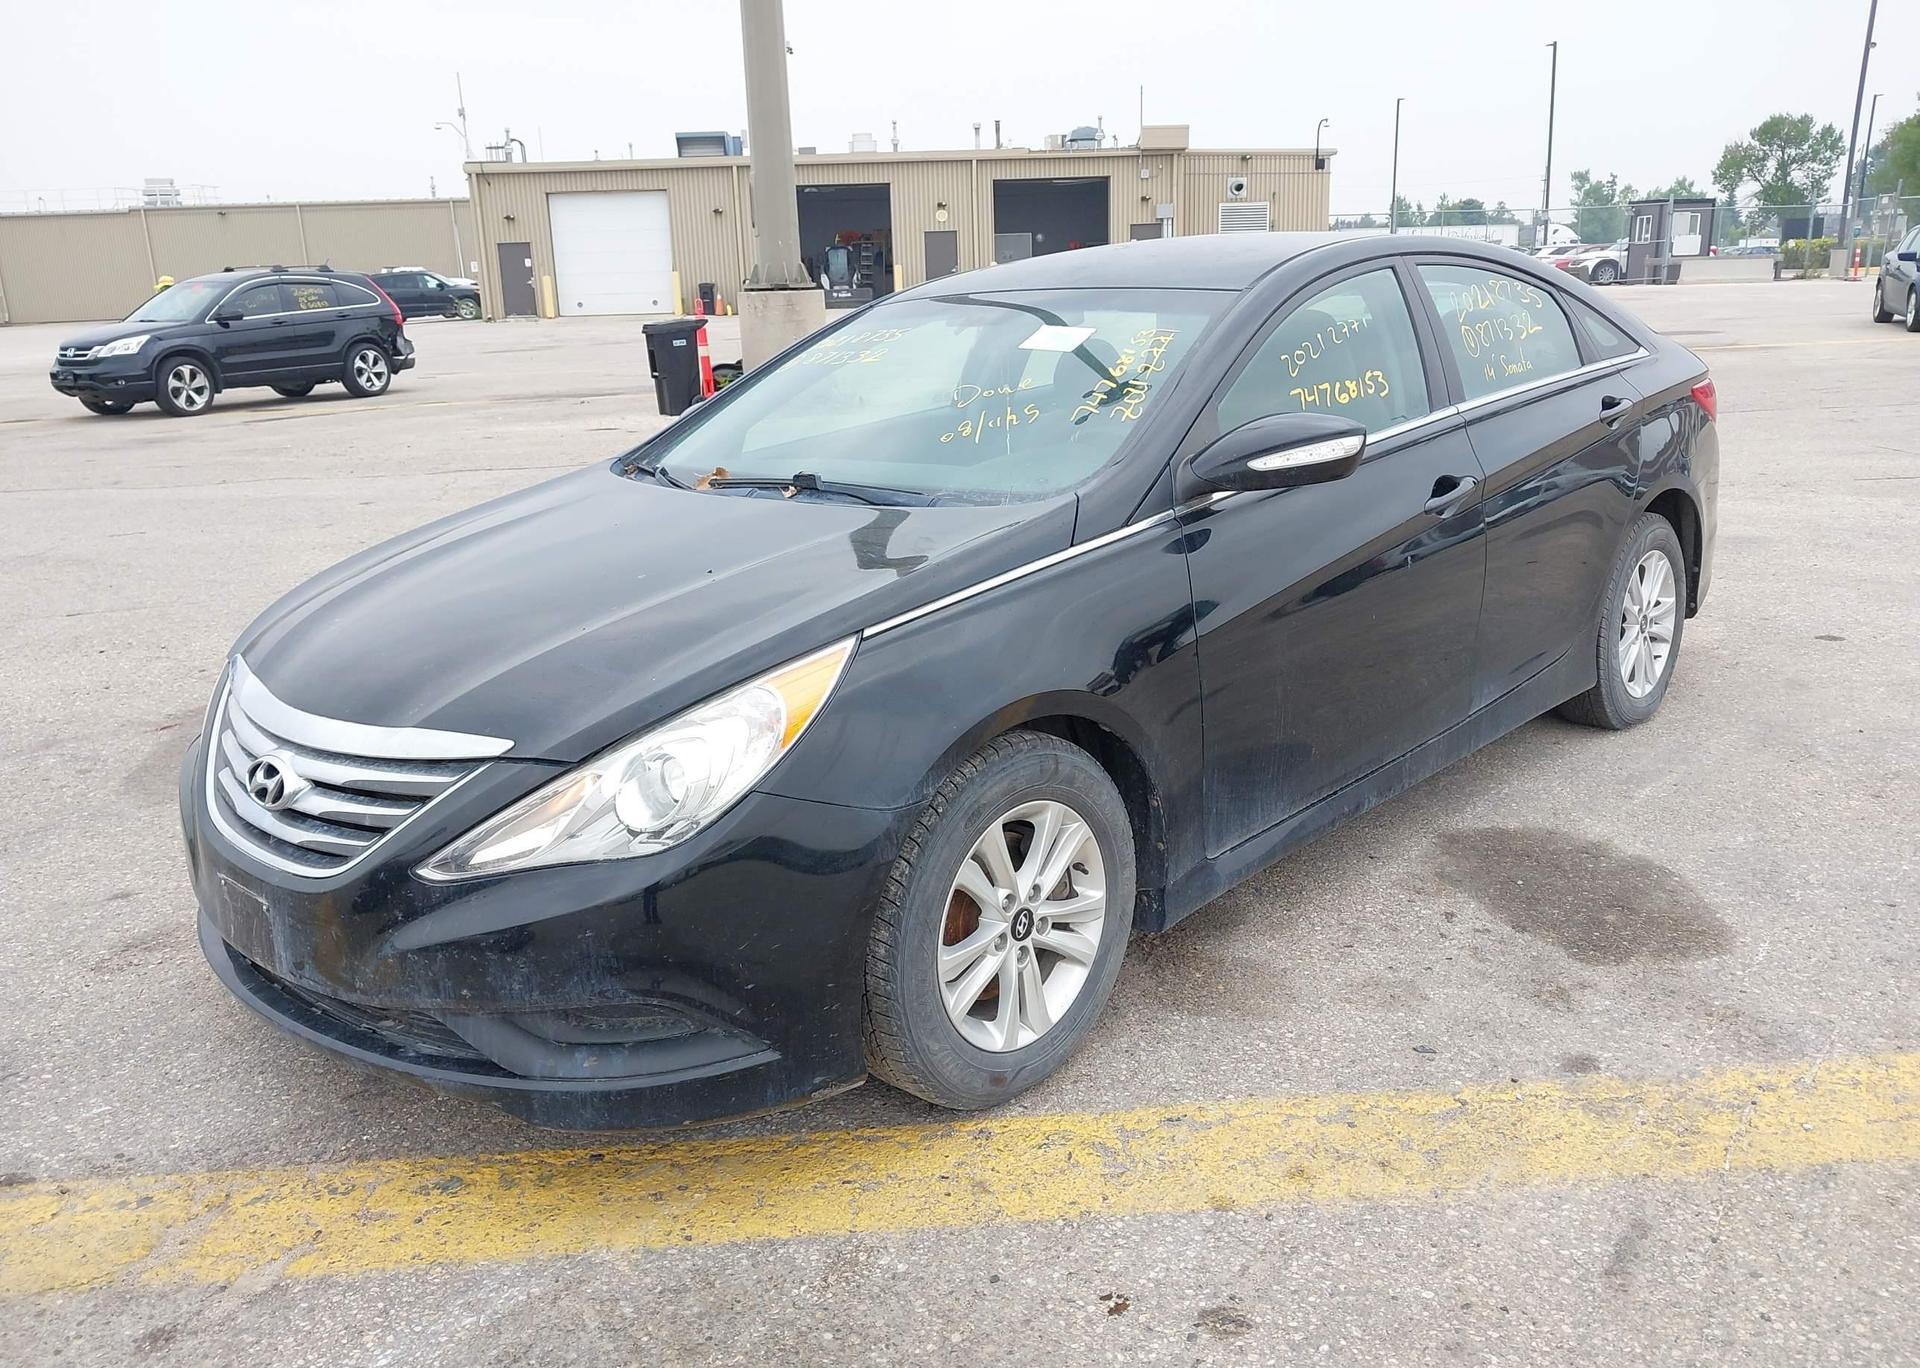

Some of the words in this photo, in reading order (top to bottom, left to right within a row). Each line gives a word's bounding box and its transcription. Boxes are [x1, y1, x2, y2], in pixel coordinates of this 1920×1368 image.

[1450, 280, 1542, 323] 20218735
[1280, 317, 1368, 377] 20212771
[1500, 346, 1533, 376] Sonata
[952, 377, 1033, 408] Done
[1069, 328, 1157, 422] 74768153
[1289, 369, 1389, 411] 74768153
